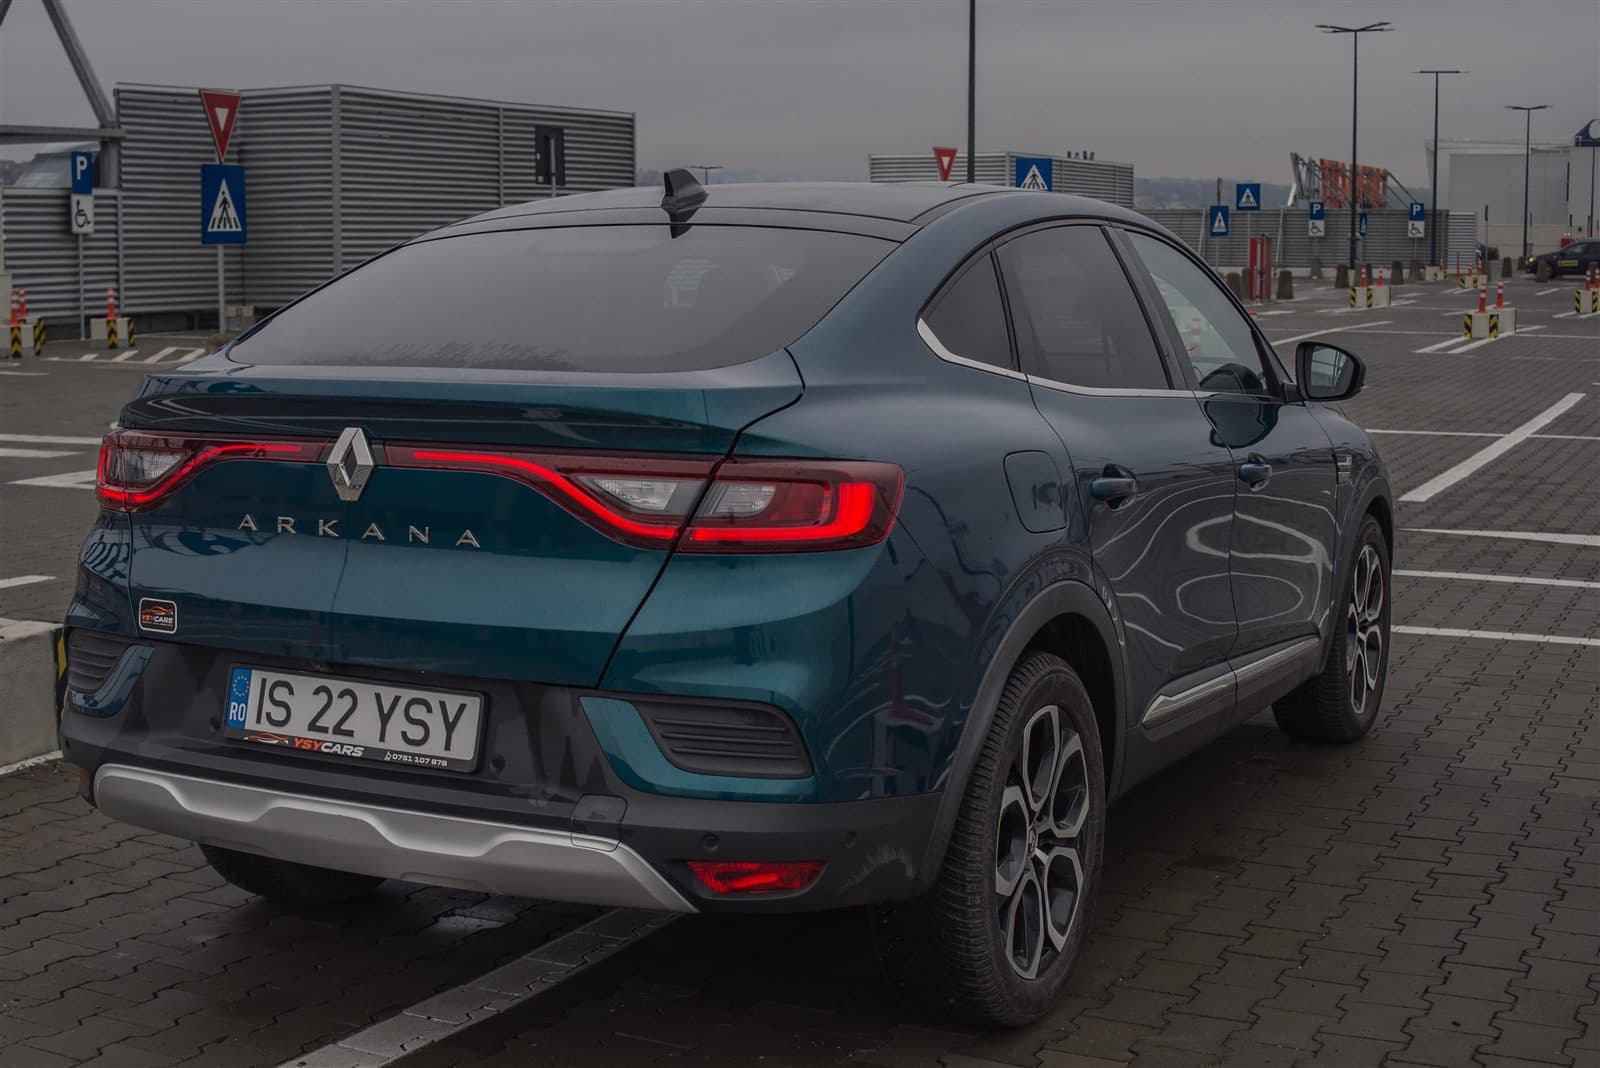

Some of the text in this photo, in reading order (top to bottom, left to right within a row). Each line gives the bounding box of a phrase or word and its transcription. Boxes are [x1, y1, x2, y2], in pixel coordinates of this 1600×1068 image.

[76, 155, 88, 180] P
[1312, 203, 1321, 213] P
[1413, 204, 1421, 215] P
[238, 513, 481, 548] ARKANA
[229, 701, 246, 722] RO
[255, 677, 467, 752] IS 22 YSY
[392, 753, 413, 762] 0751
[414, 756, 430, 764] 107
